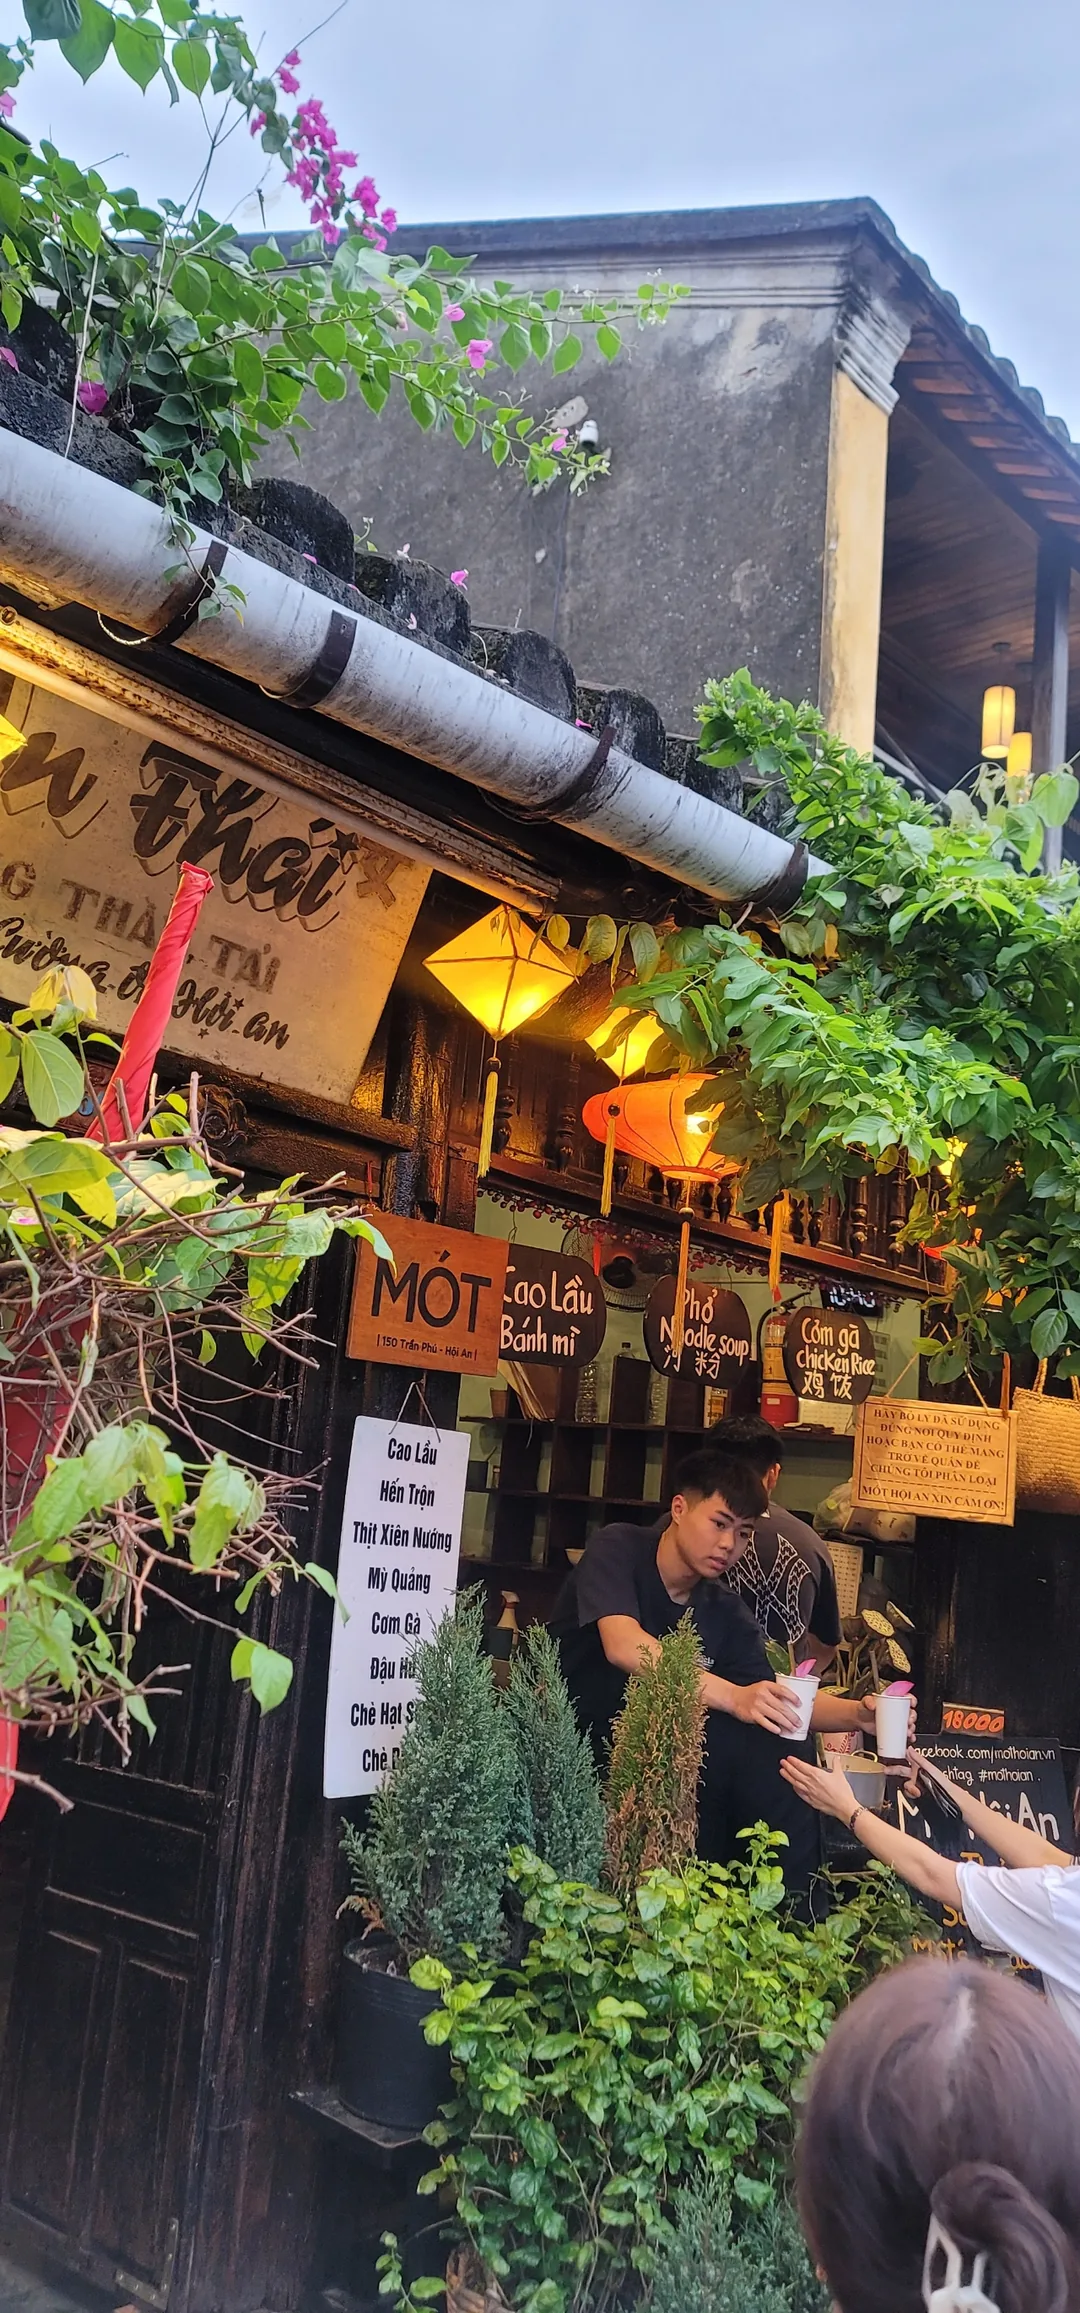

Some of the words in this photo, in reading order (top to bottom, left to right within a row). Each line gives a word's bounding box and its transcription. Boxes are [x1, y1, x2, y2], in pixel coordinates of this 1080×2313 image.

[371, 1250, 492, 1333] MÓT
[551, 1270, 594, 1315] Lầu
[382, 1335, 398, 1348] 150
[421, 1342, 438, 1354] Phú
[445, 1346, 459, 1358] Hội
[460, 1348, 473, 1359] An
[500, 1314, 547, 1353] Bánh
[552, 1325, 581, 1357] mì
[660, 1315, 717, 1353] Nodle
[719, 1335, 749, 1367] soup
[837, 1323, 860, 1356] gà
[851, 1352, 876, 1376] Rice
[880, 1421, 912, 1435] ĐÚNG
[963, 1433, 992, 1444] ĐỊNH
[918, 1413, 932, 1424] LY
[968, 1418, 1001, 1431] DỤNG
[387, 1437, 412, 1462] Cao
[415, 1440, 438, 1465] Lầu
[901, 1440, 923, 1451] BẠN
[970, 1447, 1005, 1459] MANG
[931, 1456, 963, 1468] QUÁN
[870, 1463, 911, 1476] CHÚNG
[913, 1467, 933, 1479] TÔI
[935, 1471, 966, 1482] PHÂN
[969, 1475, 997, 1487] LOẠI
[379, 1478, 404, 1504] Hến
[408, 1483, 435, 1511] Trộn
[890, 1487, 912, 1500] HỘI
[914, 1492, 931, 1502] AN
[931, 1494, 952, 1504] XIN
[353, 1521, 378, 1549] Thịt
[380, 1523, 409, 1548] Xiên
[412, 1526, 452, 1553] Nướng
[367, 1566, 388, 1593] Mỳ
[391, 1566, 431, 1594] Quảng
[371, 1611, 400, 1635] Cơm
[404, 1612, 421, 1635] Gà
[370, 1656, 396, 1684] Đậu
[350, 1701, 377, 1727] Chè
[380, 1702, 402, 1730] Hạt
[942, 1710, 1005, 1733] 18000
[362, 1746, 388, 1773] Chè
[915, 1744, 1056, 1764] acebook.com/mothoian.vn
[943, 1766, 975, 1787] shtag
